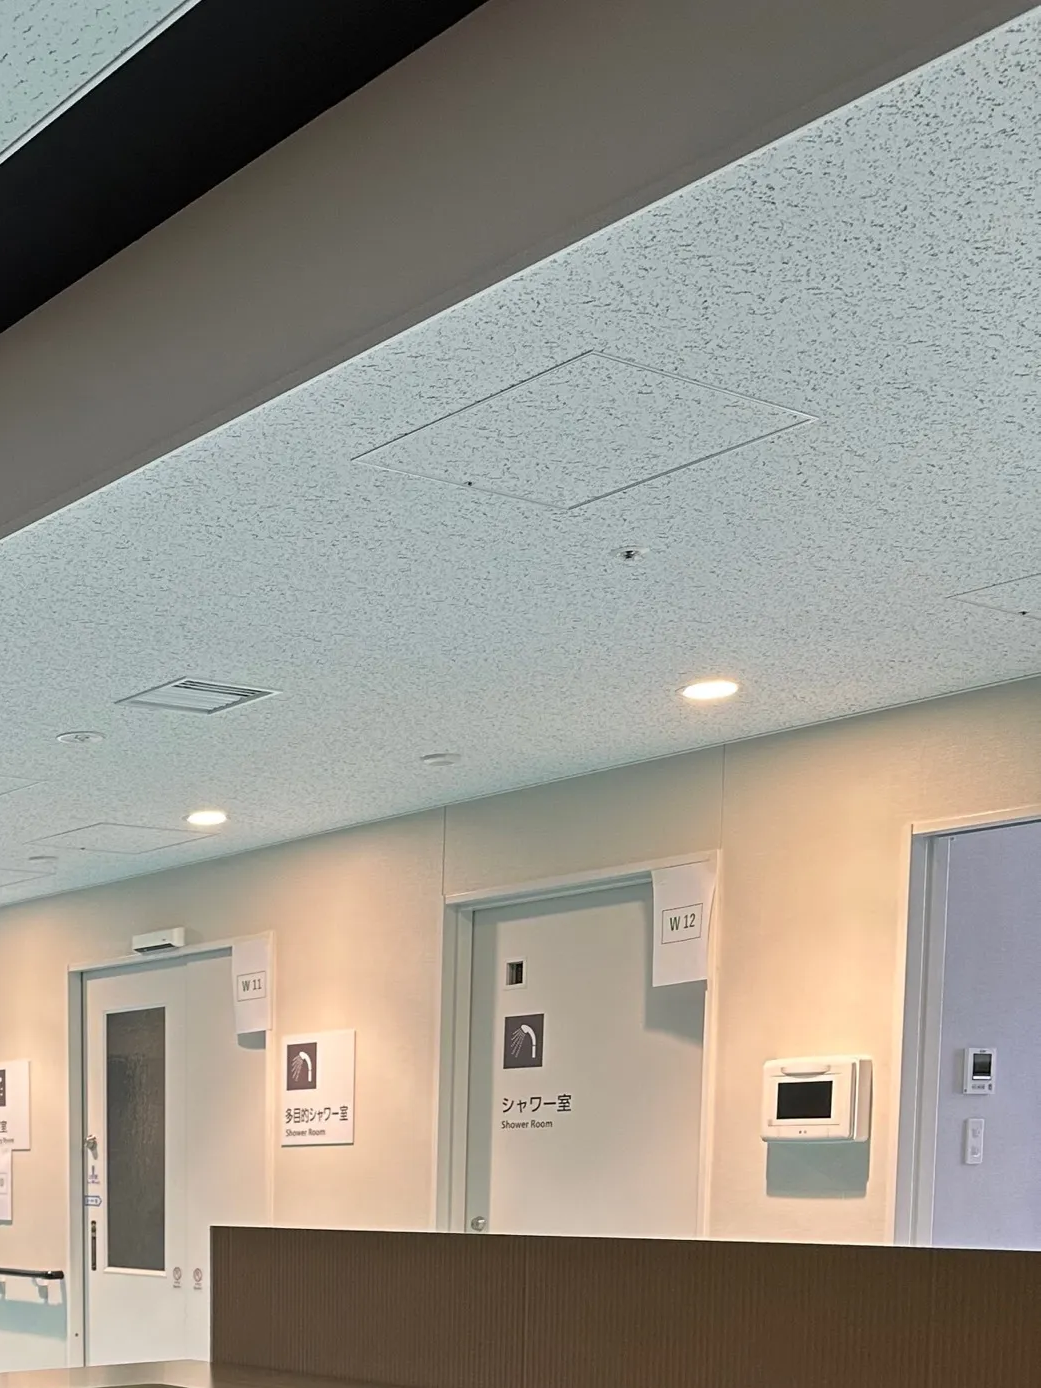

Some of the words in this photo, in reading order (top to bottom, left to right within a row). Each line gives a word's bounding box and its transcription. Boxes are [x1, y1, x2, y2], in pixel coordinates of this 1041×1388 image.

[670, 916, 680, 931] W
[684, 913, 696, 929] 12
[241, 980, 250, 992] W
[252, 978, 262, 991] 11
[502, 1094, 571, 1113] シャワー室
[285, 1105, 348, 1124] 多目的シャワー室
[286, 1129, 307, 1137] Shower
[308, 1128, 326, 1136] Room
[501, 1120, 529, 1129] Shower
[530, 1120, 553, 1128] Room
